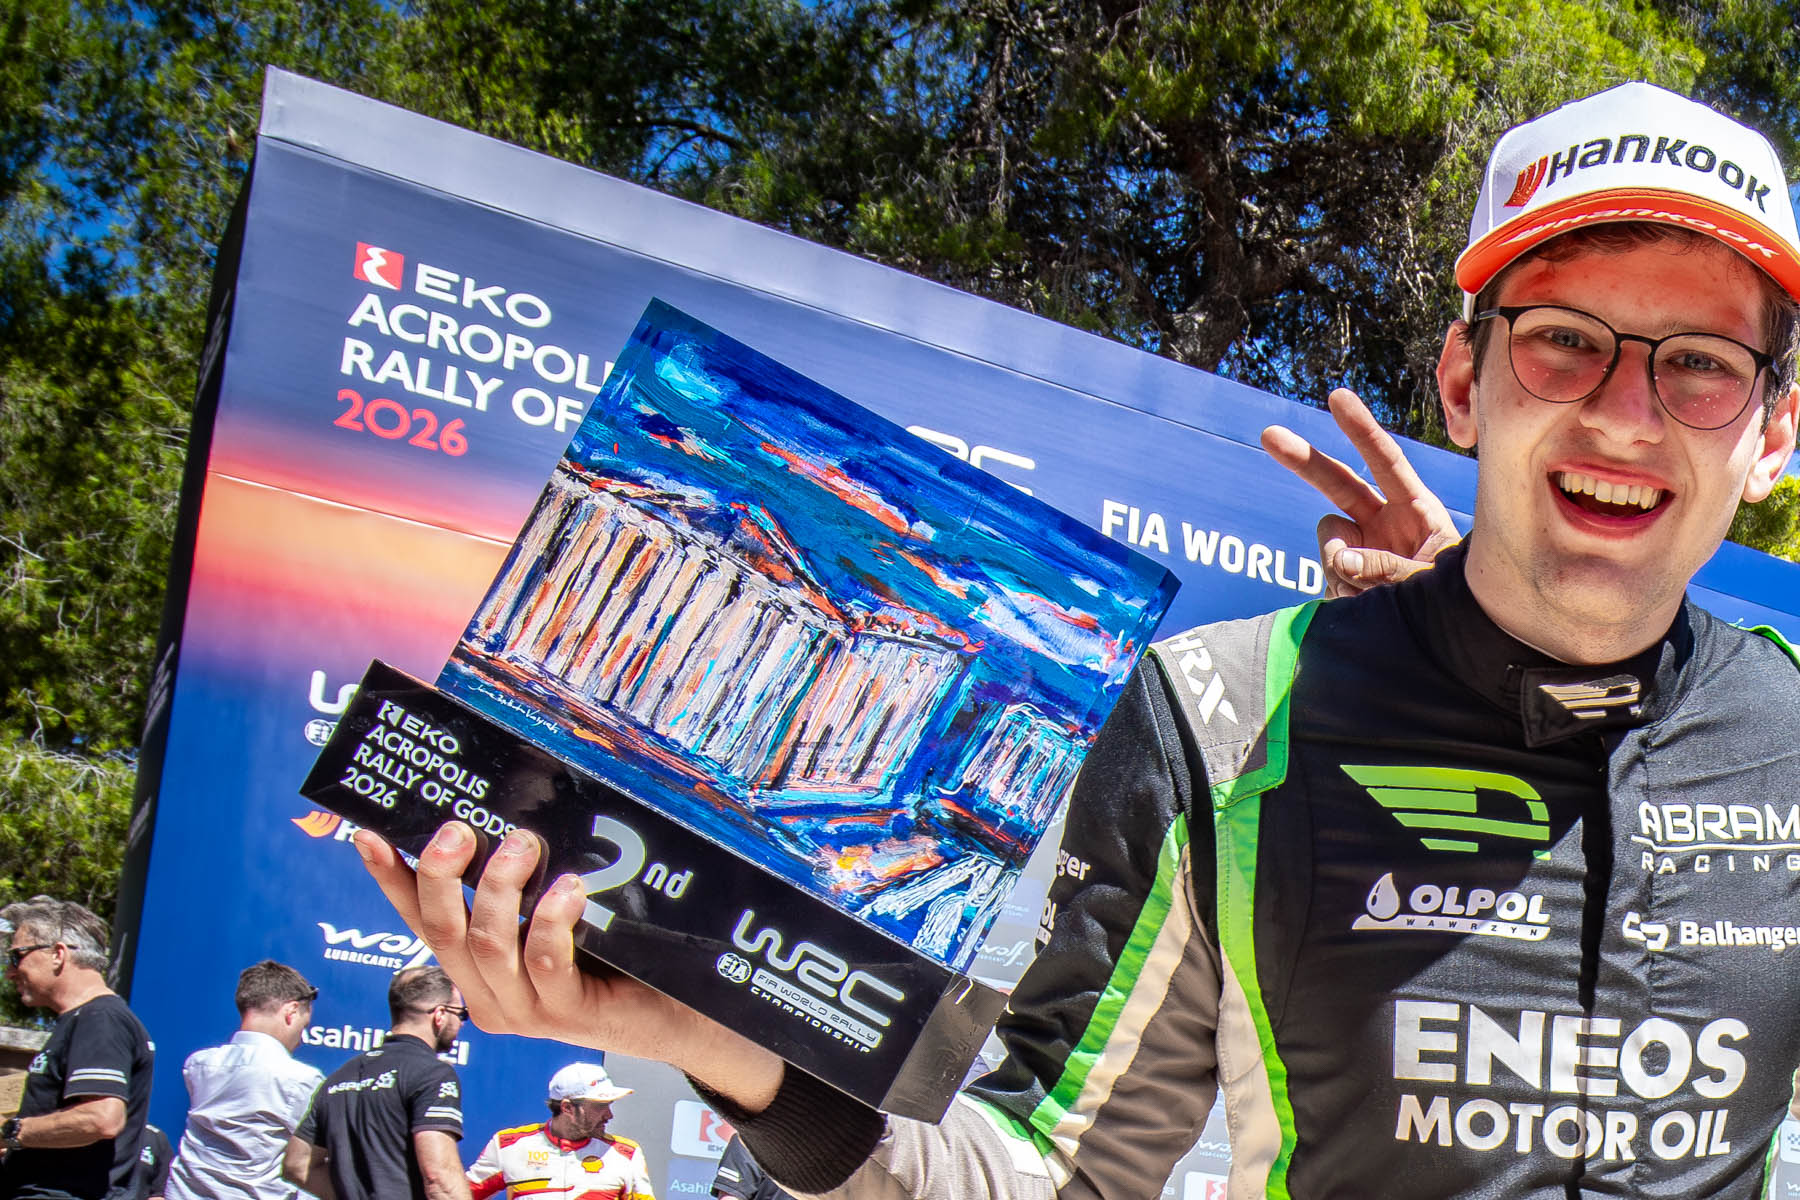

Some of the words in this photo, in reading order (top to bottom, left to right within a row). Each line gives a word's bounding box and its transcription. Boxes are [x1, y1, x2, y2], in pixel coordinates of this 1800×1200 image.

[414, 263, 552, 328] EKO
[340, 337, 504, 413] RALLY
[511, 387, 584, 433] OF
[333, 389, 469, 457] 2026
[1101, 498, 1170, 555] FIA
[1181, 521, 1325, 596] WORLD
[1168, 633, 1240, 726] HRX
[366, 724, 492, 799] ACROPOLIS
[401, 713, 460, 755] EKO
[339, 767, 400, 809] 2026
[353, 743, 423, 790] RALLY
[421, 781, 454, 808] OF
[581, 814, 694, 932] 2nd
[1409, 884, 1551, 923] OLPOL
[323, 947, 404, 970] LUBRICANTS
[1406, 917, 1538, 937] WAWRZYN
[718, 953, 750, 981] FIA
[731, 908, 905, 1028] WRC
[750, 985, 872, 1055] CHAMPIONSHIP
[779, 984, 829, 1017] WORLD
[829, 1013, 878, 1044] RALLY
[1393, 999, 1751, 1099] ENEOS
[1394, 1093, 1639, 1161] MOTOR
[1649, 1108, 1732, 1161] OIL
